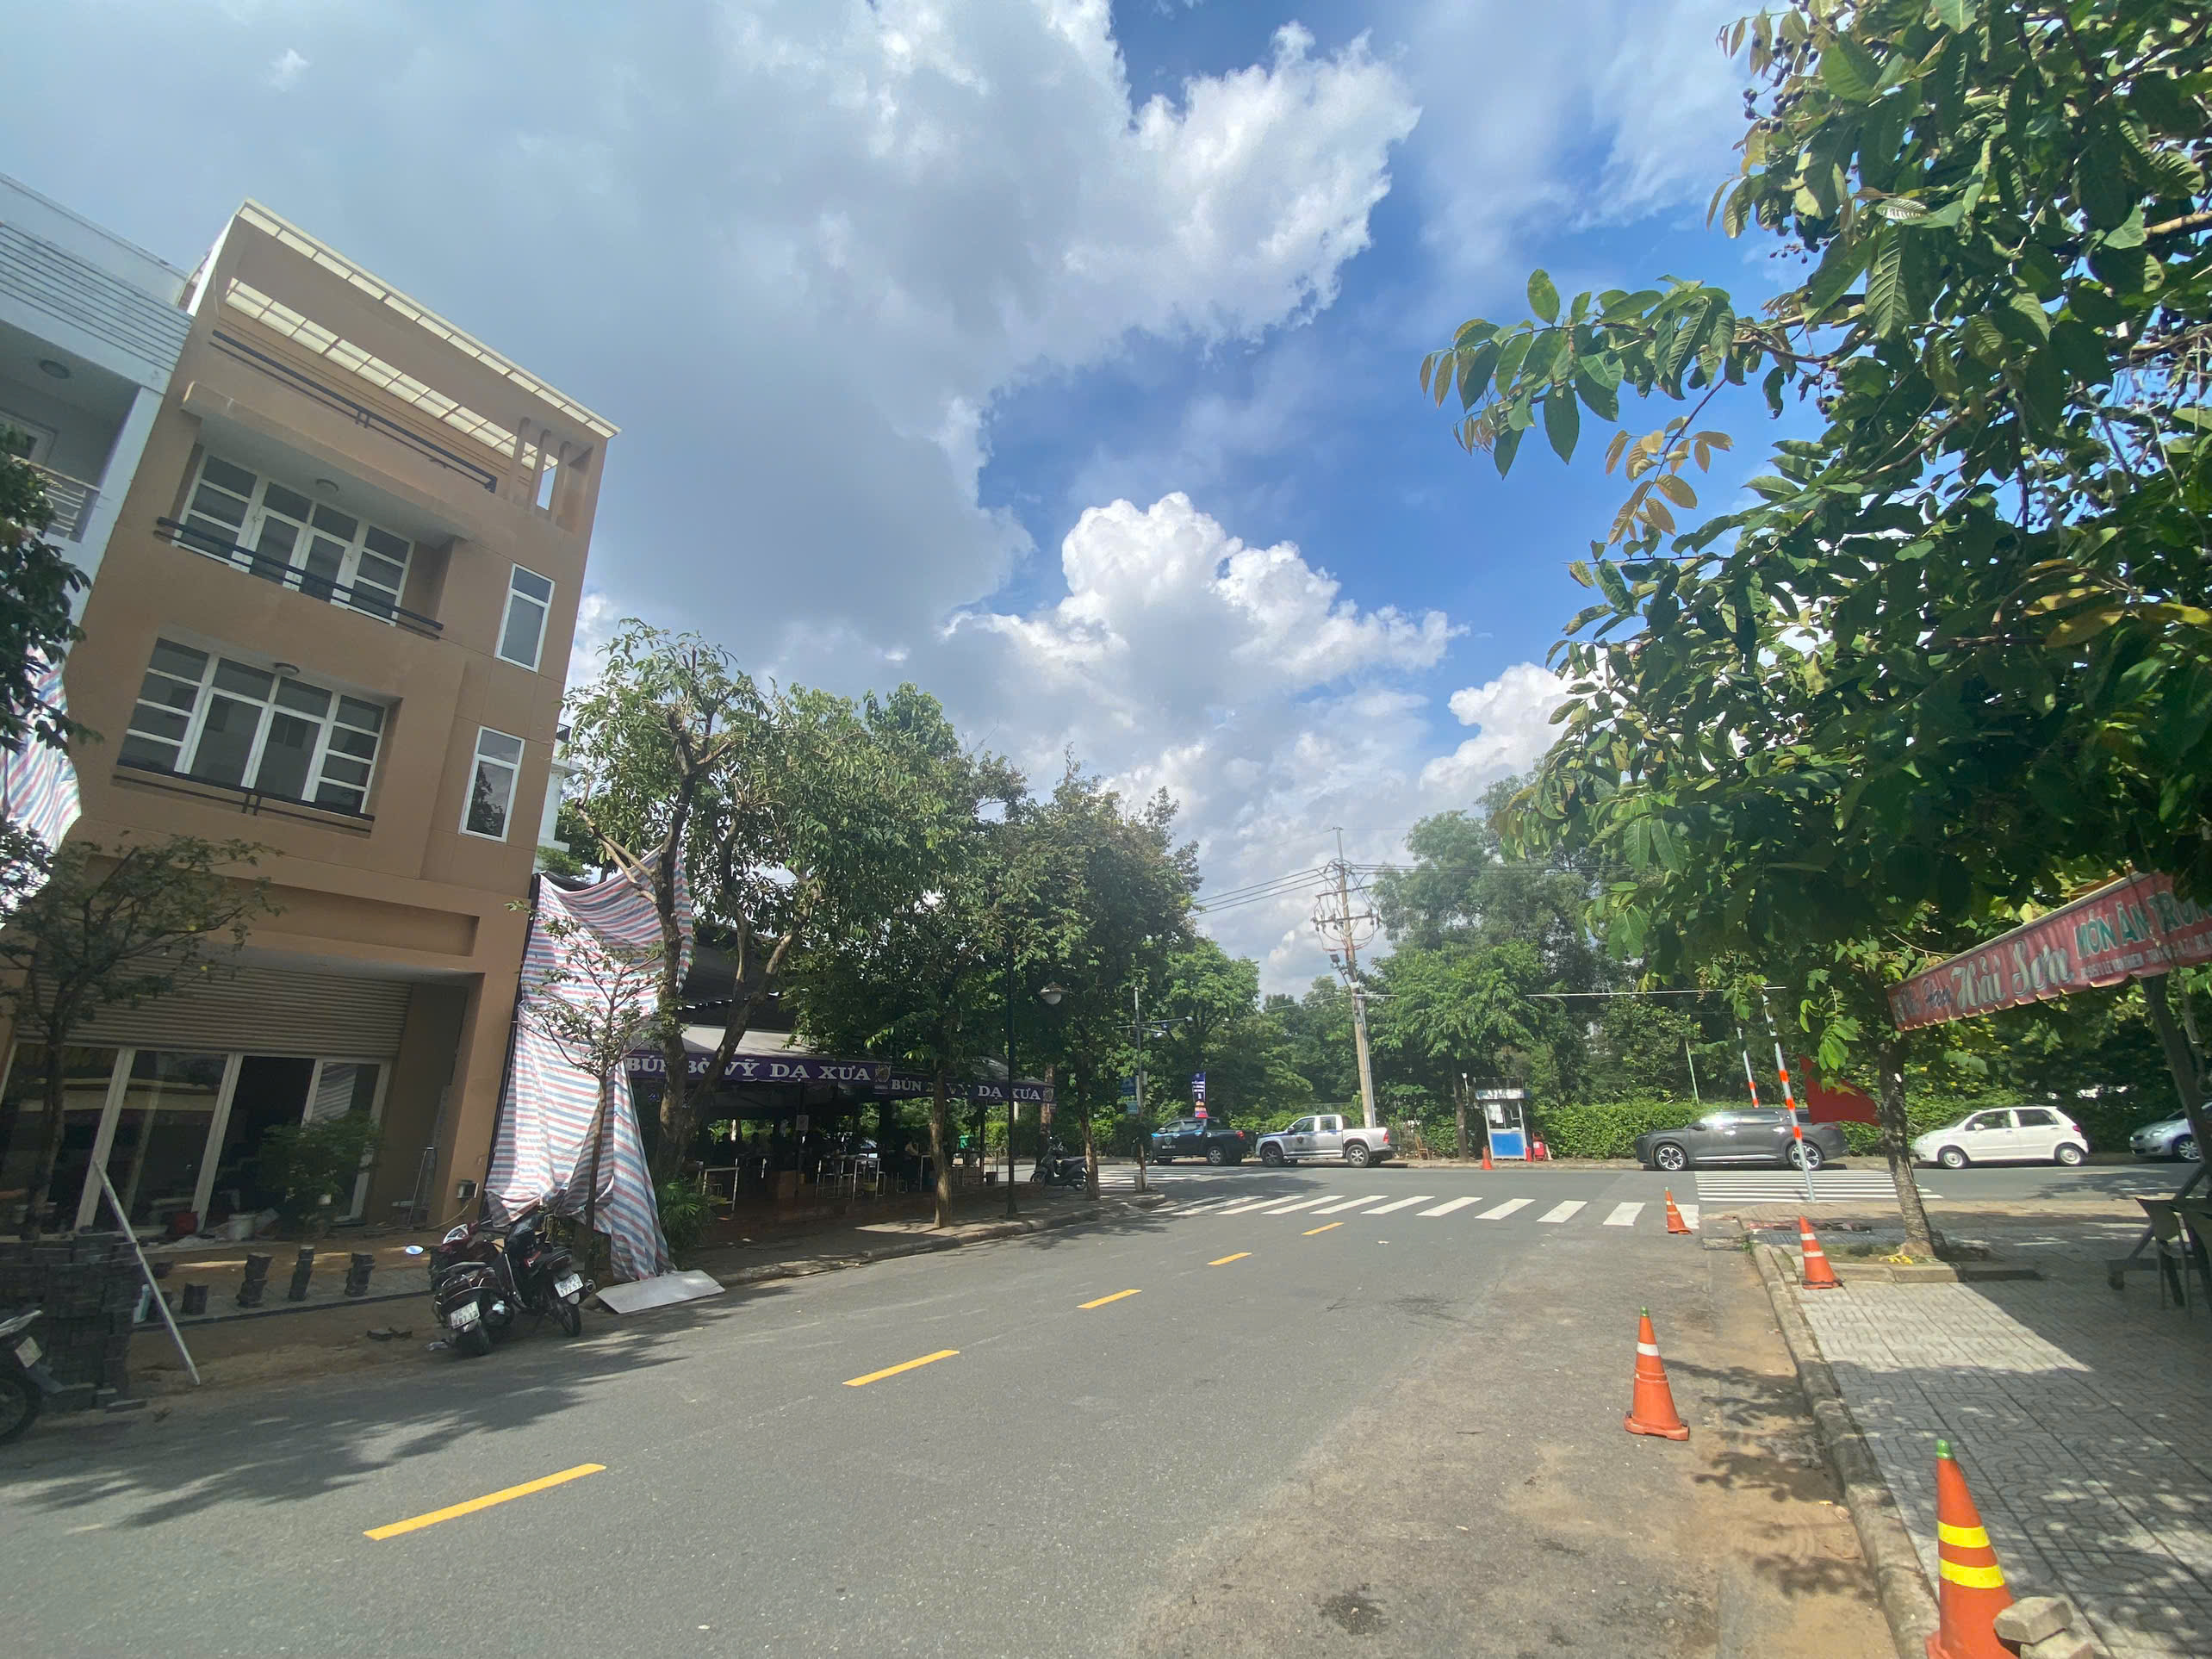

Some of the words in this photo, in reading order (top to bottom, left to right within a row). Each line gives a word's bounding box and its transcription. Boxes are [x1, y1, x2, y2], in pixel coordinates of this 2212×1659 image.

[769, 1063, 810, 1082] DẠ
[818, 1065, 871, 1080] XƯA
[892, 1077, 922, 1091] BÚN
[978, 1084, 1003, 1099] DẠ
